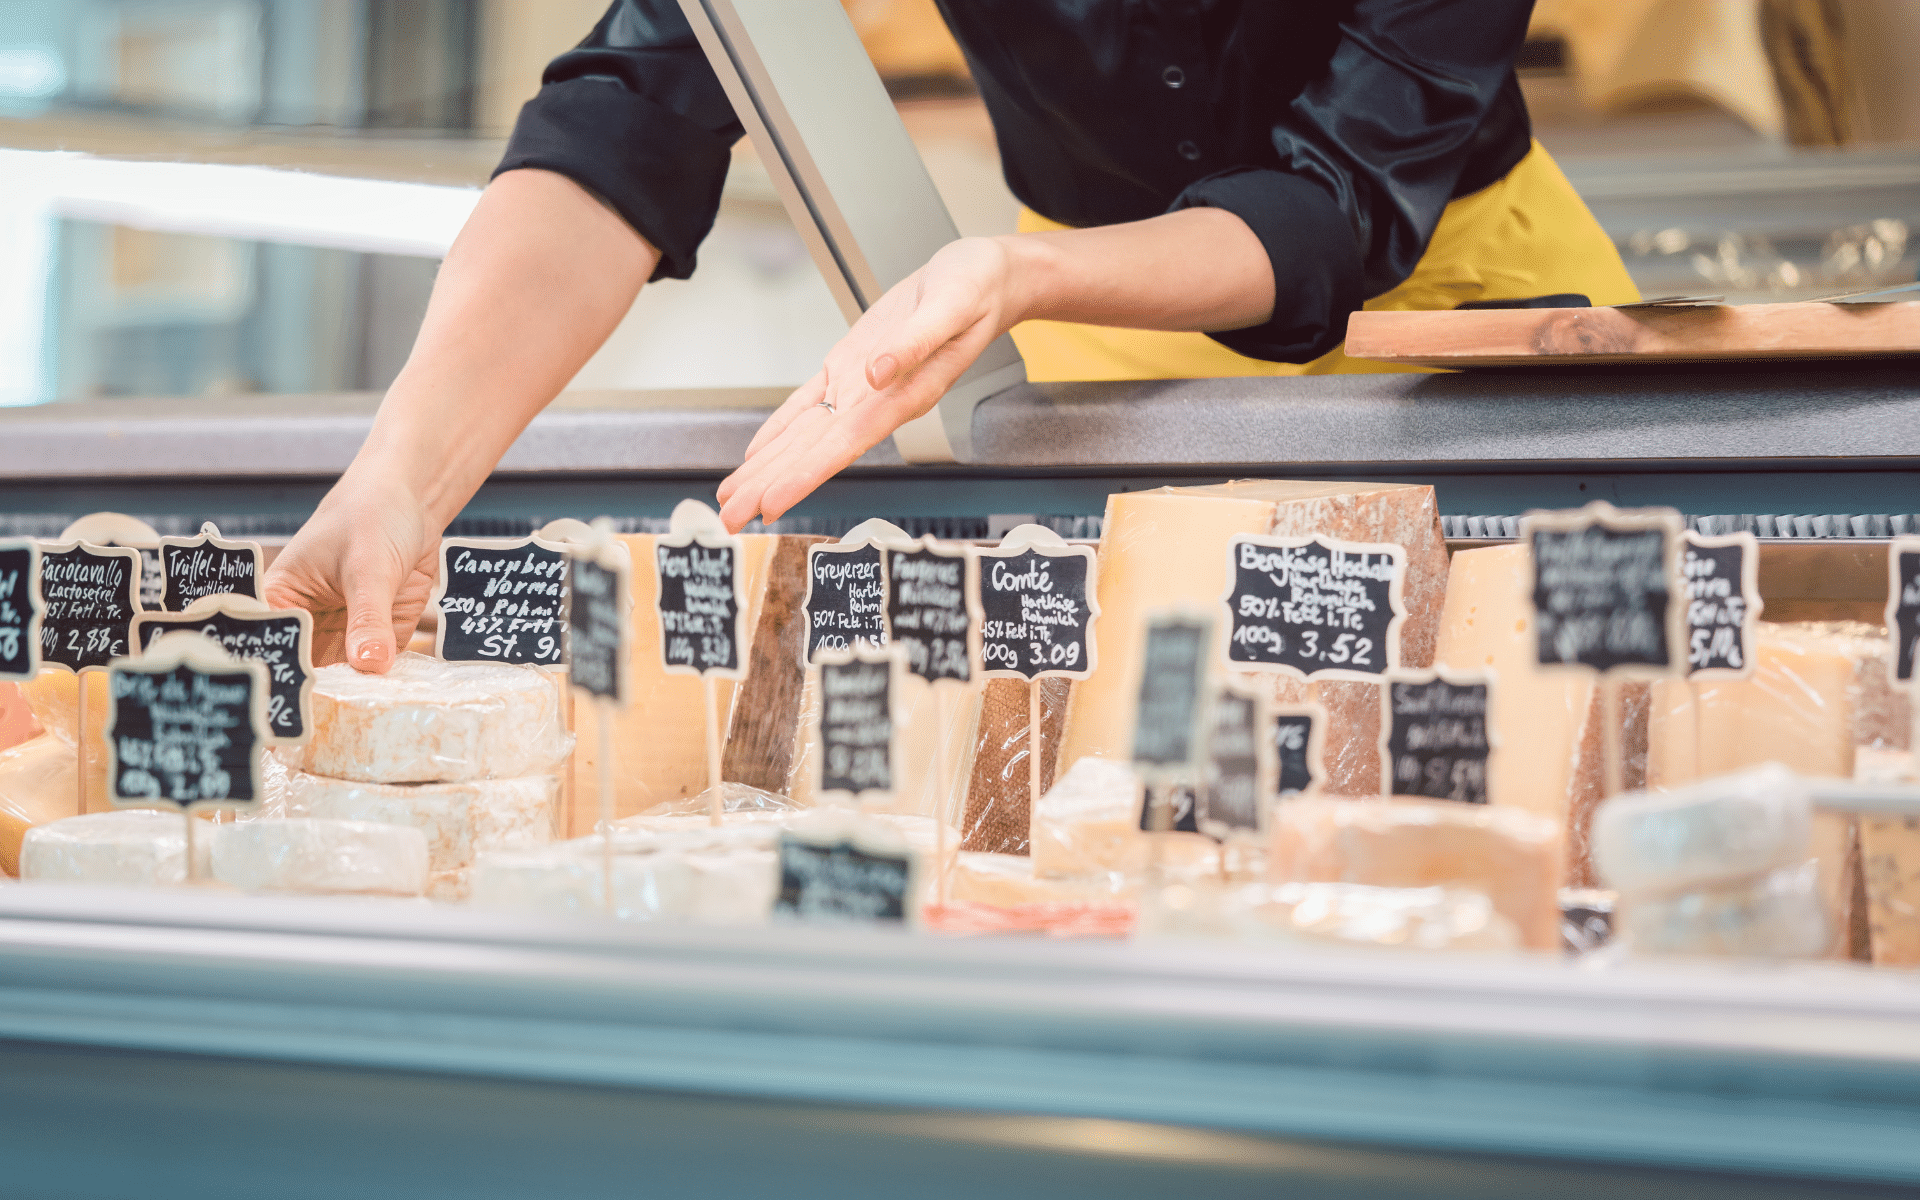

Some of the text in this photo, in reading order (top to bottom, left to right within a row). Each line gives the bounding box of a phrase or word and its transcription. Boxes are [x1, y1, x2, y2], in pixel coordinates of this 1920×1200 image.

[40, 555, 123, 588] Caciocavallo
[814, 553, 880, 590] Greyerzer
[991, 559, 1054, 593] Comté
[1240, 544, 1328, 588] Bergkäse
[1021, 593, 1079, 614] Hartkäse
[1238, 594, 1281, 619] 50%
[1281, 601, 1325, 625] Fett
[460, 616, 503, 635] 45%
[813, 609, 836, 629] 50%
[837, 611, 862, 629] Fett
[979, 620, 1004, 639] 45%
[1022, 607, 1079, 628] Rohmilch
[477, 633, 522, 658] St.
[979, 641, 1018, 669] 100g
[1029, 641, 1080, 667] 3.09
[1232, 624, 1374, 666] 100g 3,52
[272, 662, 295, 685] Tr.
